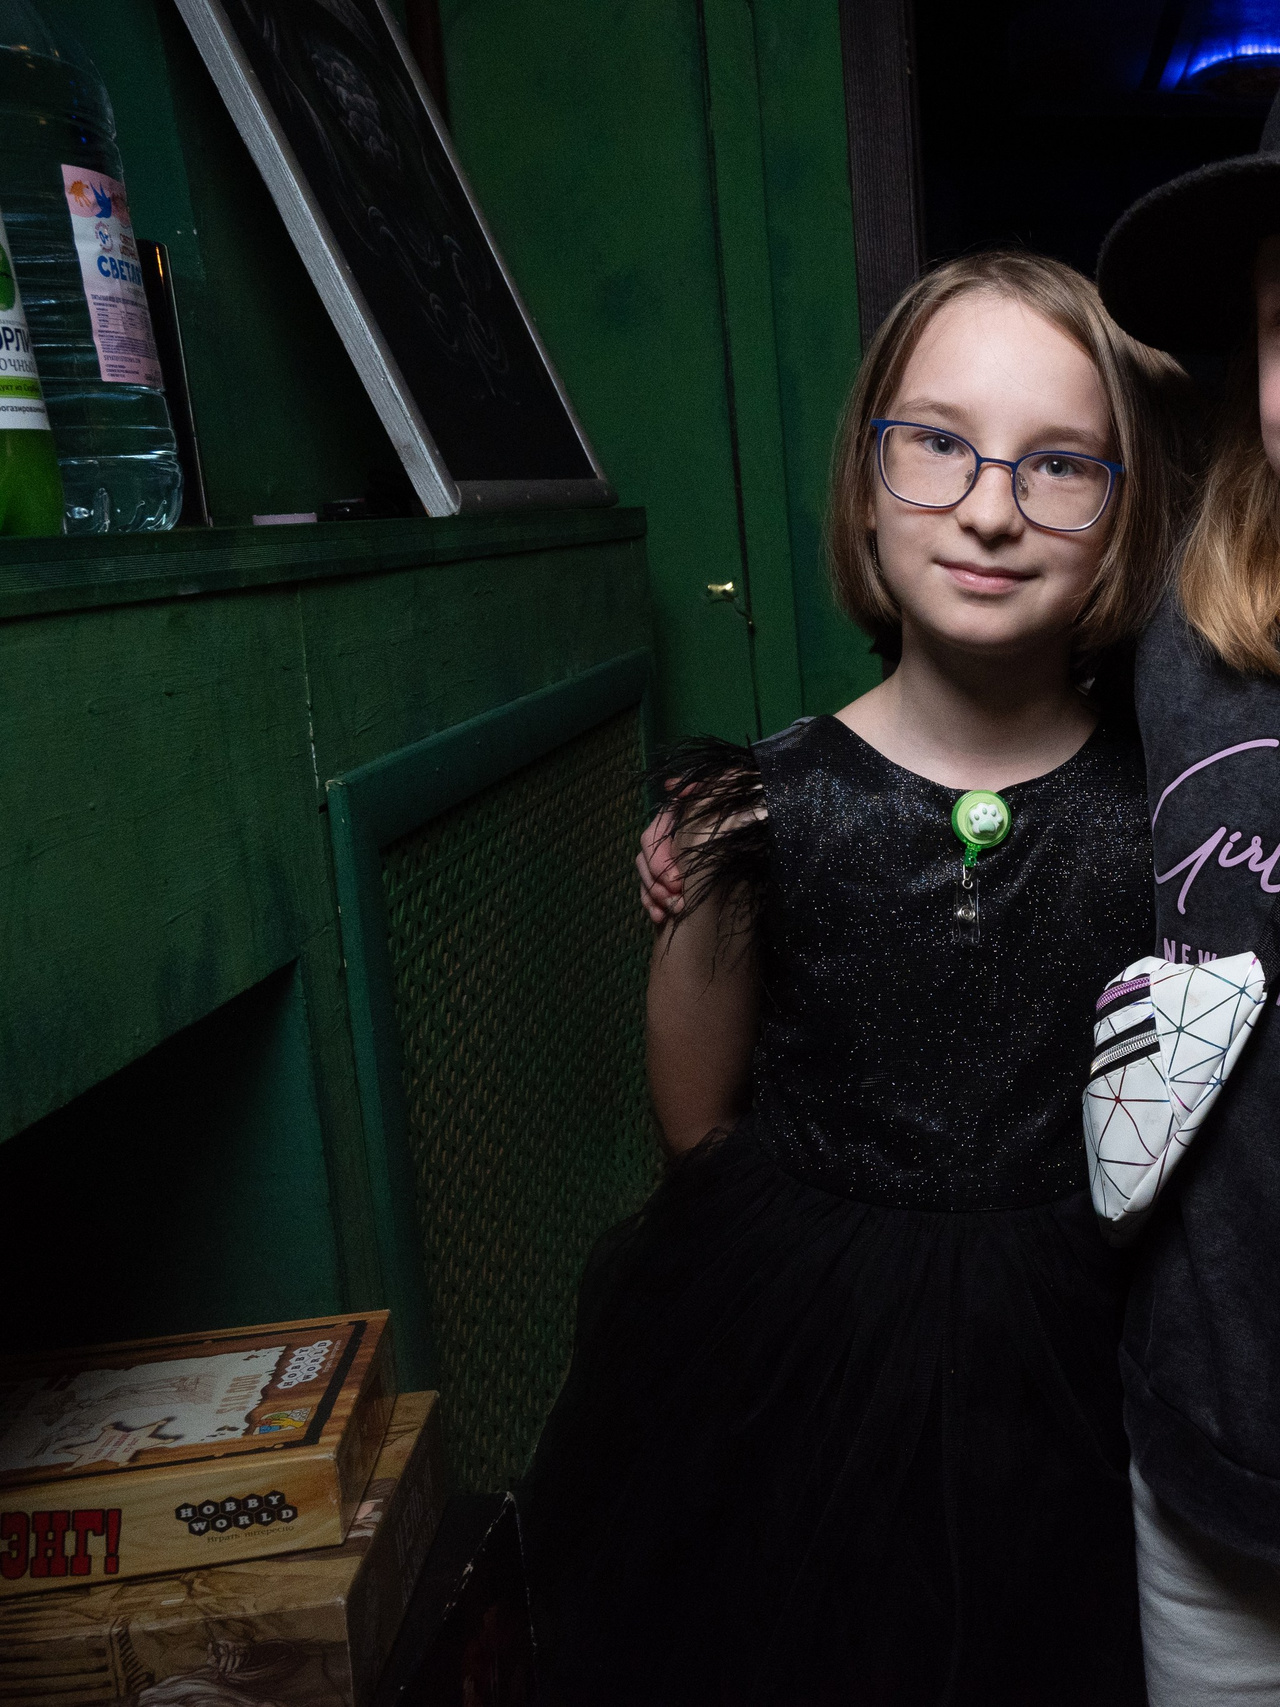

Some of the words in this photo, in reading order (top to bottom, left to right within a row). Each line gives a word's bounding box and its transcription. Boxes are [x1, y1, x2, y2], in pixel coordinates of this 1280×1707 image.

[280, 1347, 310, 1388] HOBBY
[301, 1341, 328, 1381] WORLD
[179, 1494, 281, 1518] HOBBY
[190, 1508, 294, 1532] WORLD
[0, 1508, 122, 1580] ЭНГ!
